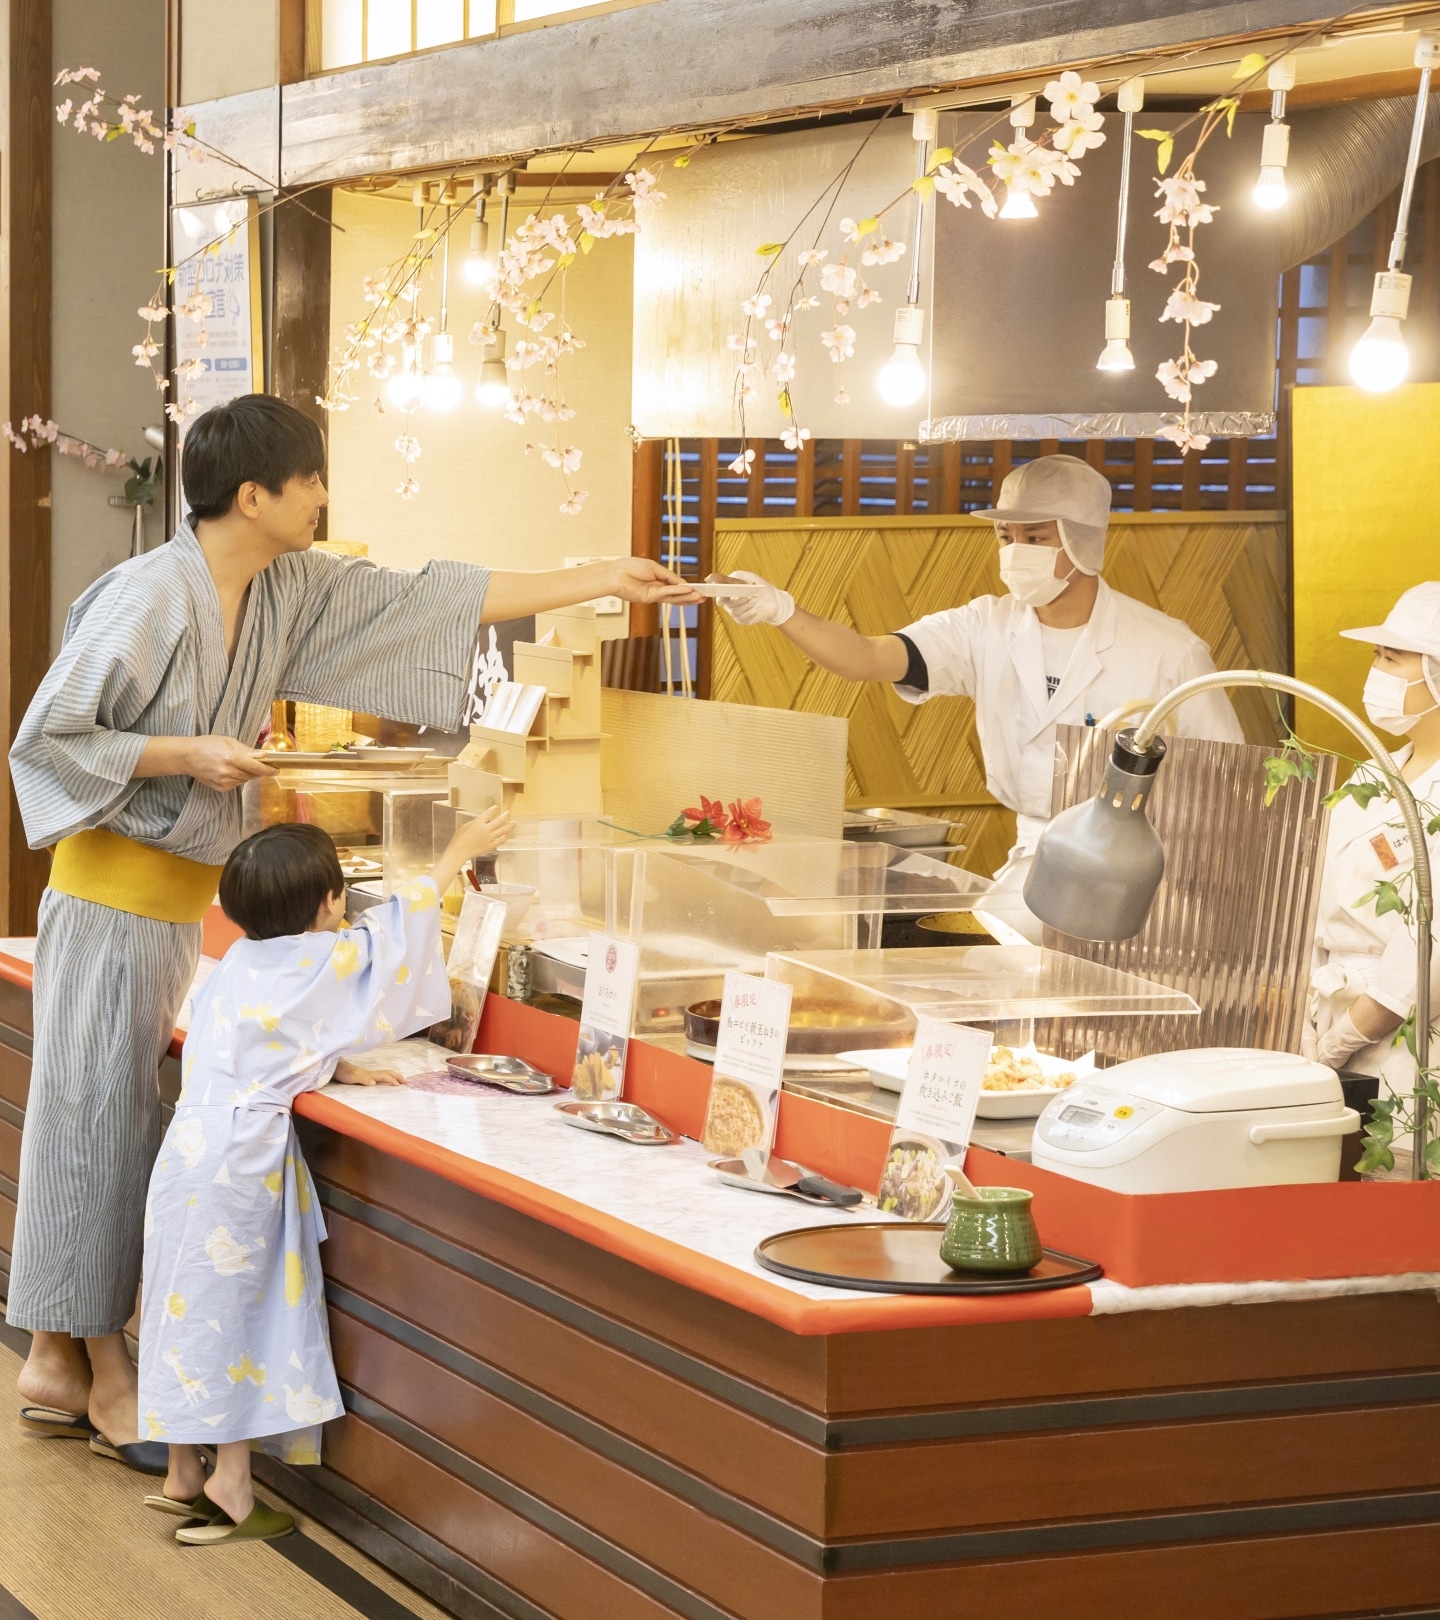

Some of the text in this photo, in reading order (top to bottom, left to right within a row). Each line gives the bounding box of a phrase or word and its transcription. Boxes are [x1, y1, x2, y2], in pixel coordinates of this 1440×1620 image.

[177, 253, 245, 288] 新型コロナ対策
[598, 985, 618, 1001] まぐろカツ
[733, 993, 757, 1009] 春限定
[925, 1042, 952, 1060] 春限定
[923, 1070, 967, 1090] ホタルイカの
[918, 1082, 964, 1108] 炊き込みご飯
